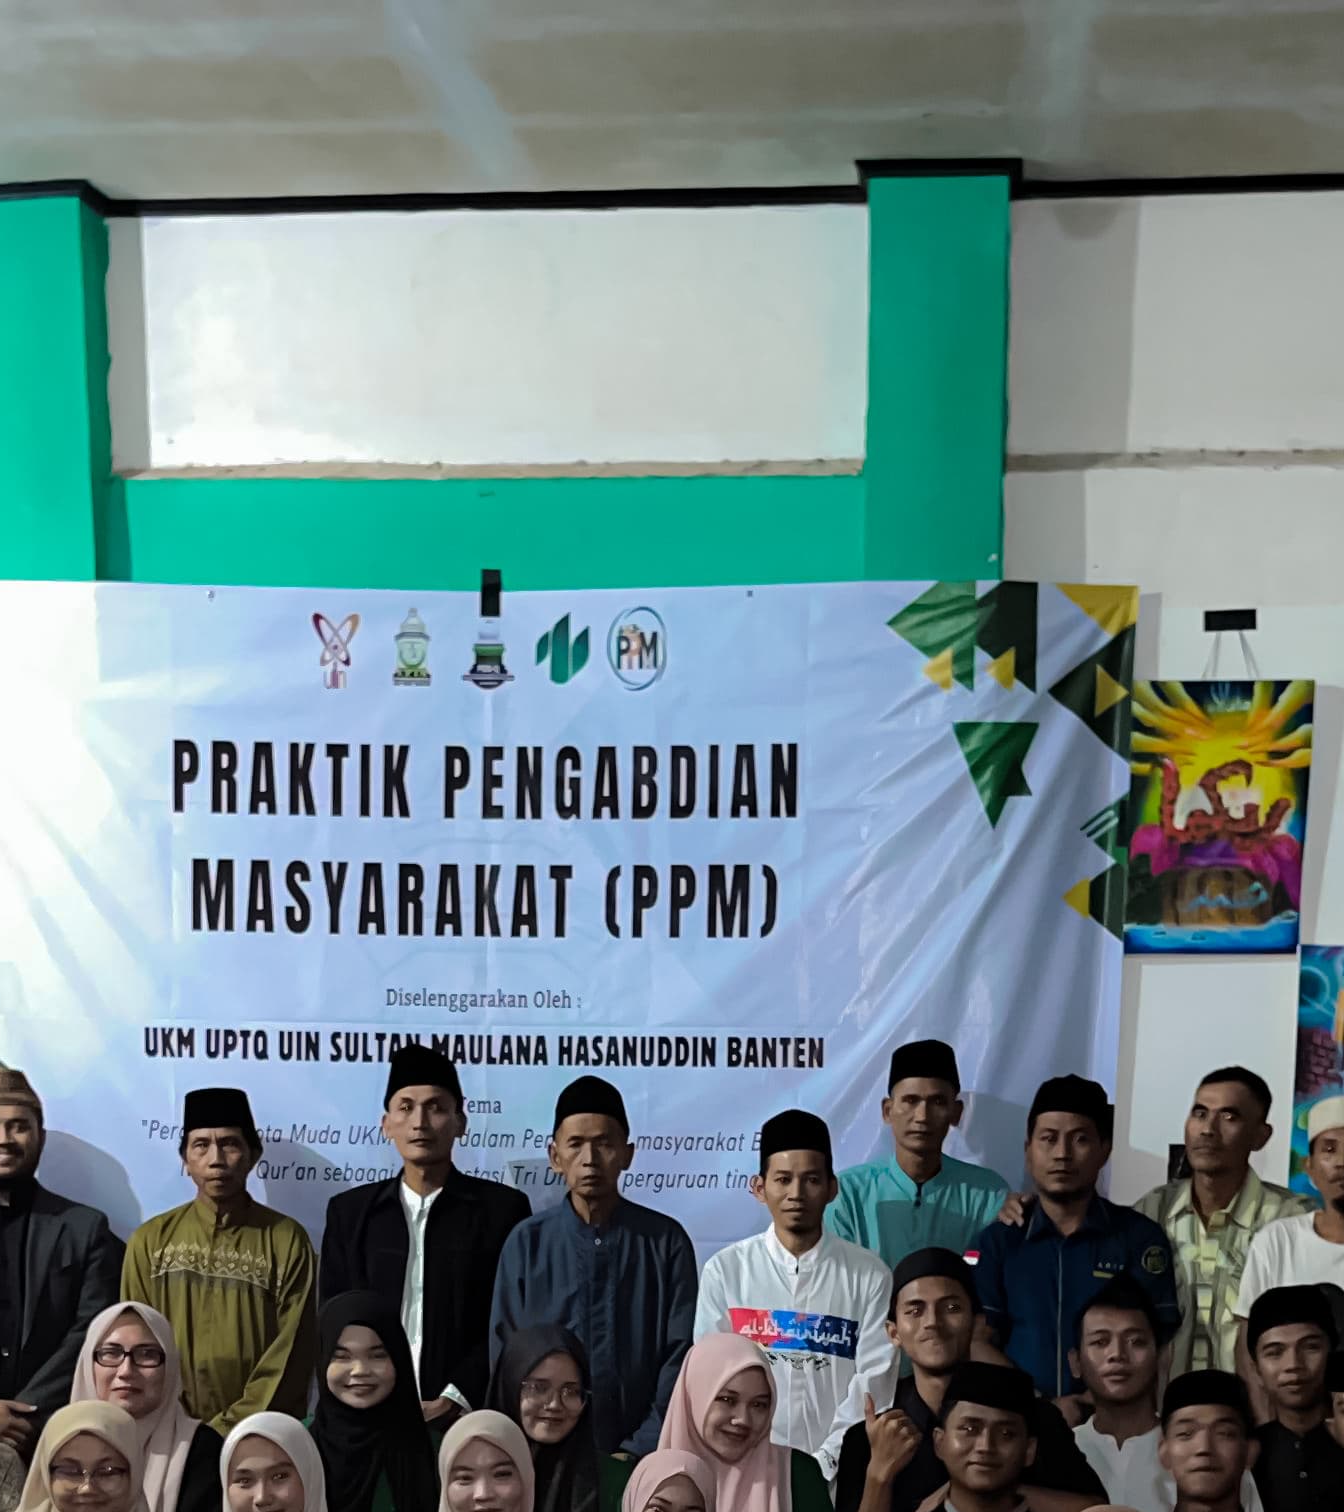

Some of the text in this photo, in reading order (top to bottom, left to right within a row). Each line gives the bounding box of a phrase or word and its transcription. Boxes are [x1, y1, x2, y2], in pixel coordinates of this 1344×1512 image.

[173, 739, 798, 820] PRAKTIK PENGABDIAN
[191, 857, 779, 939] MASYARAKAT (PPM)
[386, 987, 529, 1012] Diselenggarakan
[533, 989, 572, 1009] Oleh
[144, 1027, 195, 1058] UKM
[205, 1028, 269, 1061] UPTQ
[279, 1030, 320, 1062] UIN
[431, 1033, 549, 1066] MAULANA
[557, 1035, 717, 1068] HASANUDDIN
[727, 1036, 825, 1069] BANTEN
[462, 1096, 503, 1115] ema
[289, 1123, 341, 1145] Muda
[459, 1128, 516, 1149] dalam
[635, 1131, 746, 1157] masyarakat
[513, 1165, 540, 1186] Tri
[621, 1169, 719, 1194] perguruan
